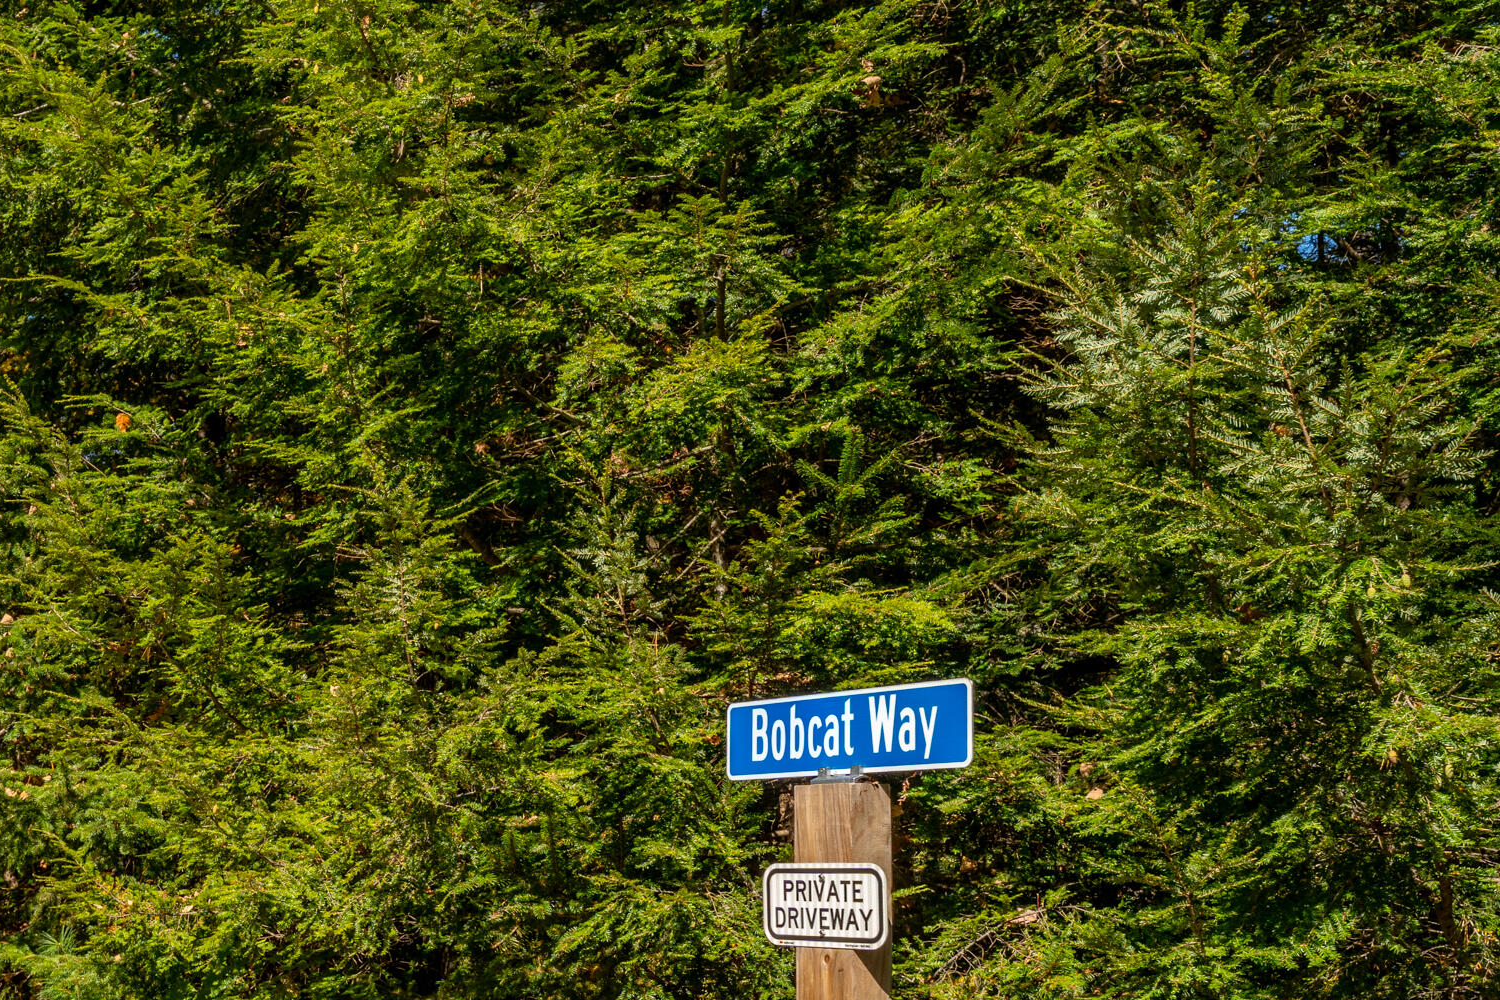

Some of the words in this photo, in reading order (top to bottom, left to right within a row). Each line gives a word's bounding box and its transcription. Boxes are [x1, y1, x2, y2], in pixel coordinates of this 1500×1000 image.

[751, 698, 854, 762] Bobcat
[868, 694, 938, 759] Way
[783, 880, 864, 903] PRIVATE
[775, 907, 874, 932] DRIVEWAY
